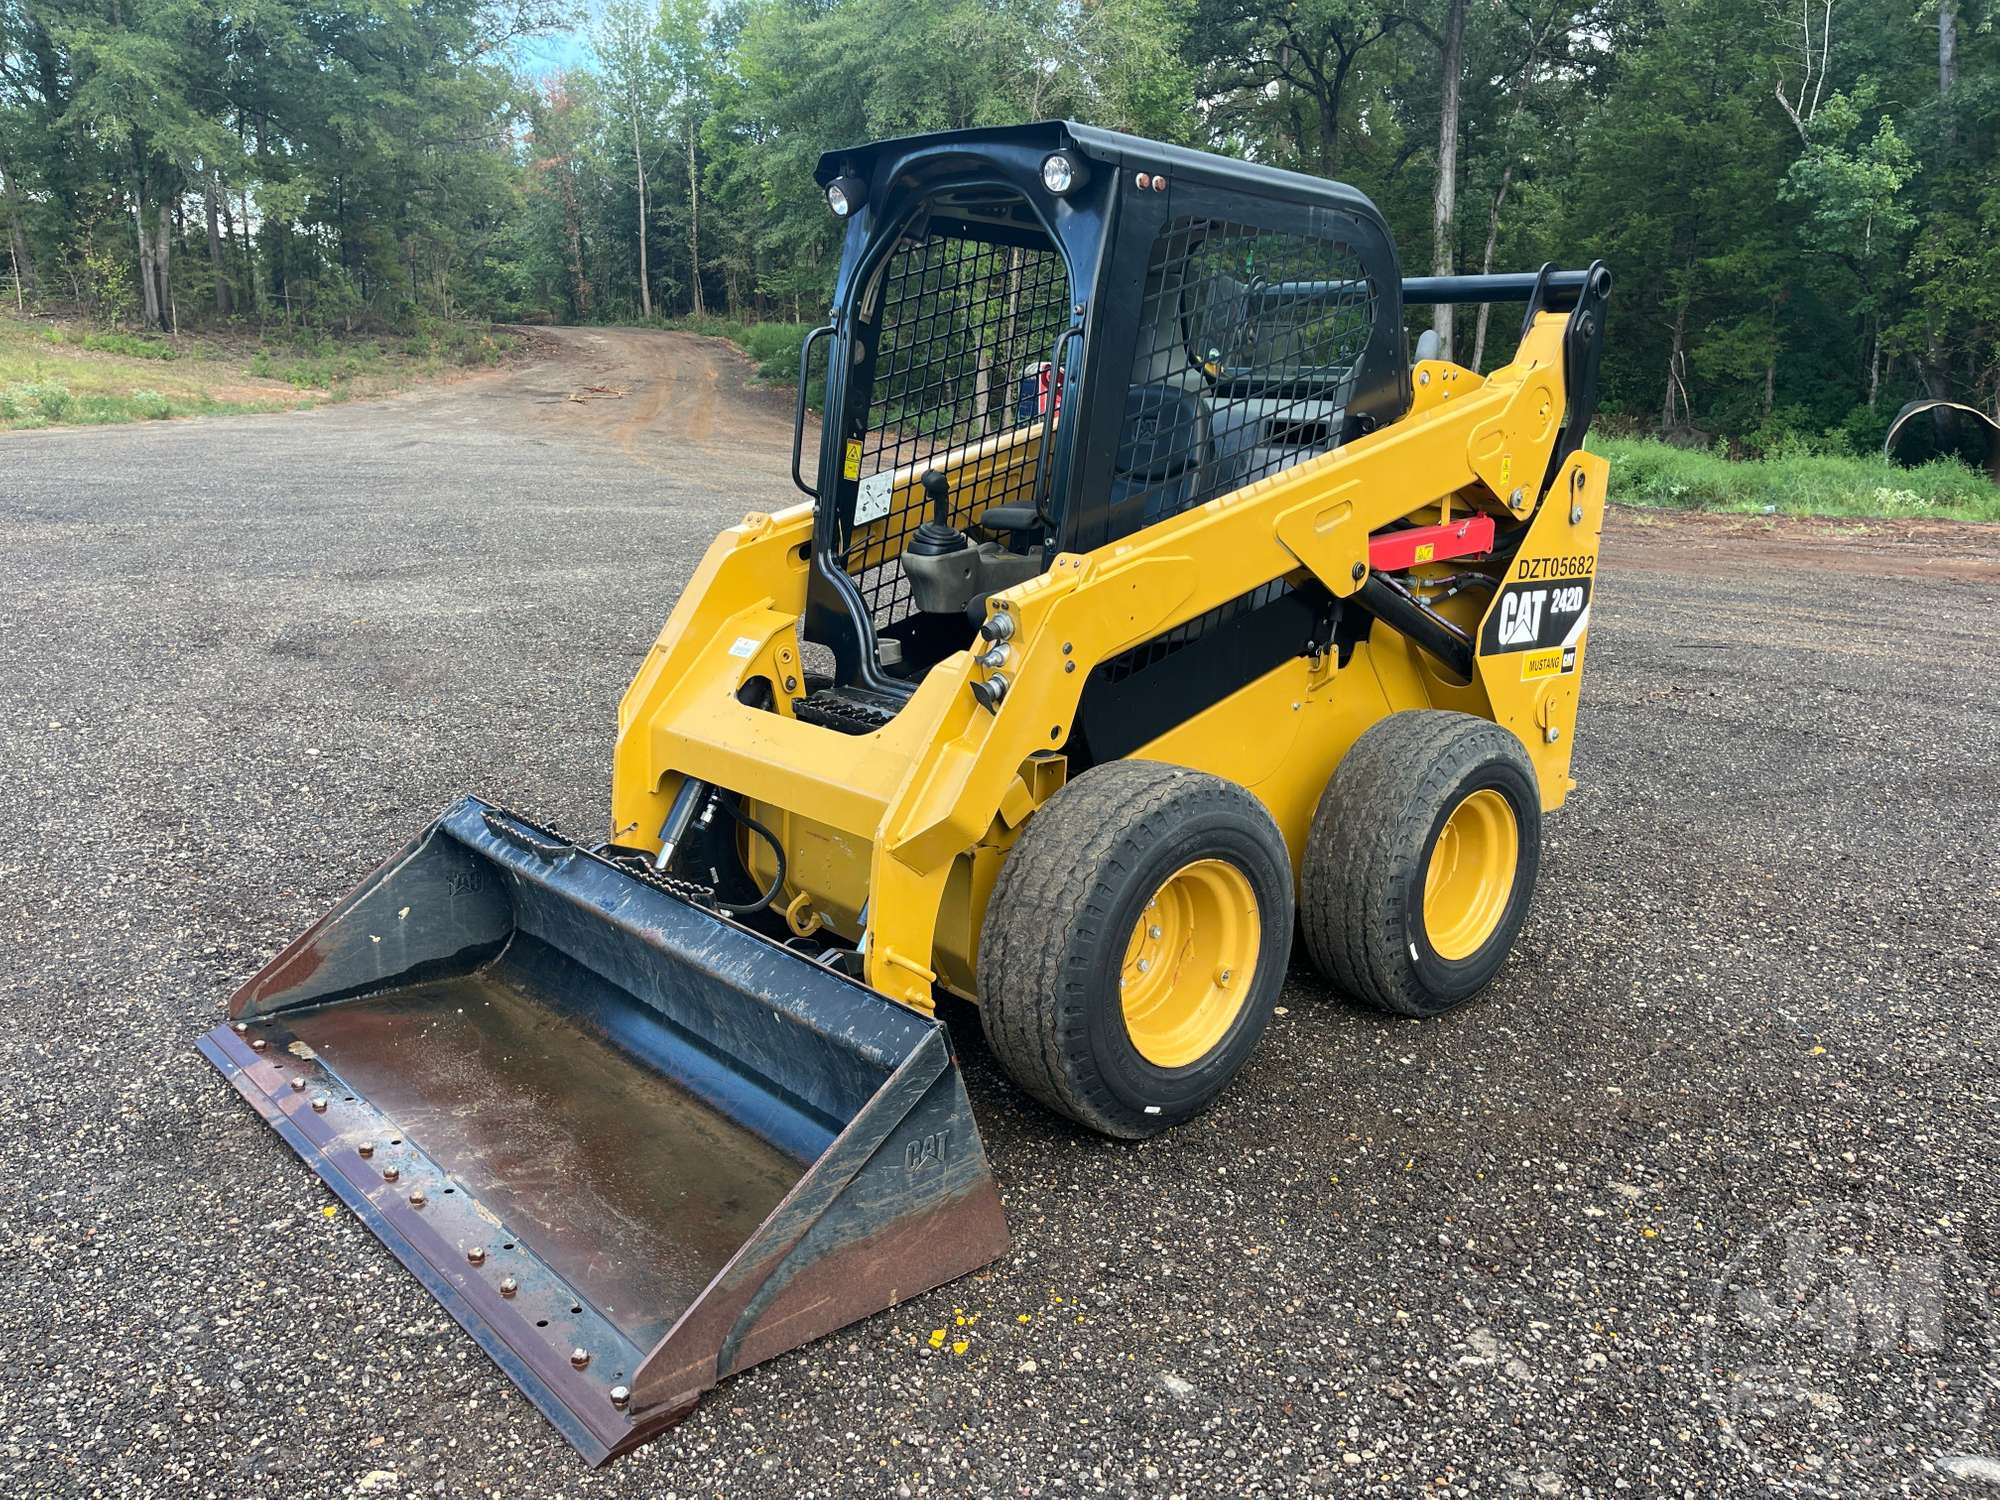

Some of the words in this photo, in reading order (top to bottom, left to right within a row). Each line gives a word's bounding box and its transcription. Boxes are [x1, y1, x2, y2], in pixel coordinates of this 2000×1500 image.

[1518, 555, 1594, 579] DZT05682
[1498, 590, 1547, 645] CAT
[1550, 586, 1583, 613] 242D
[1529, 657, 1560, 672] MUSTANG
[1562, 653, 1575, 667] CAT
[905, 1129, 950, 1173] CAT
